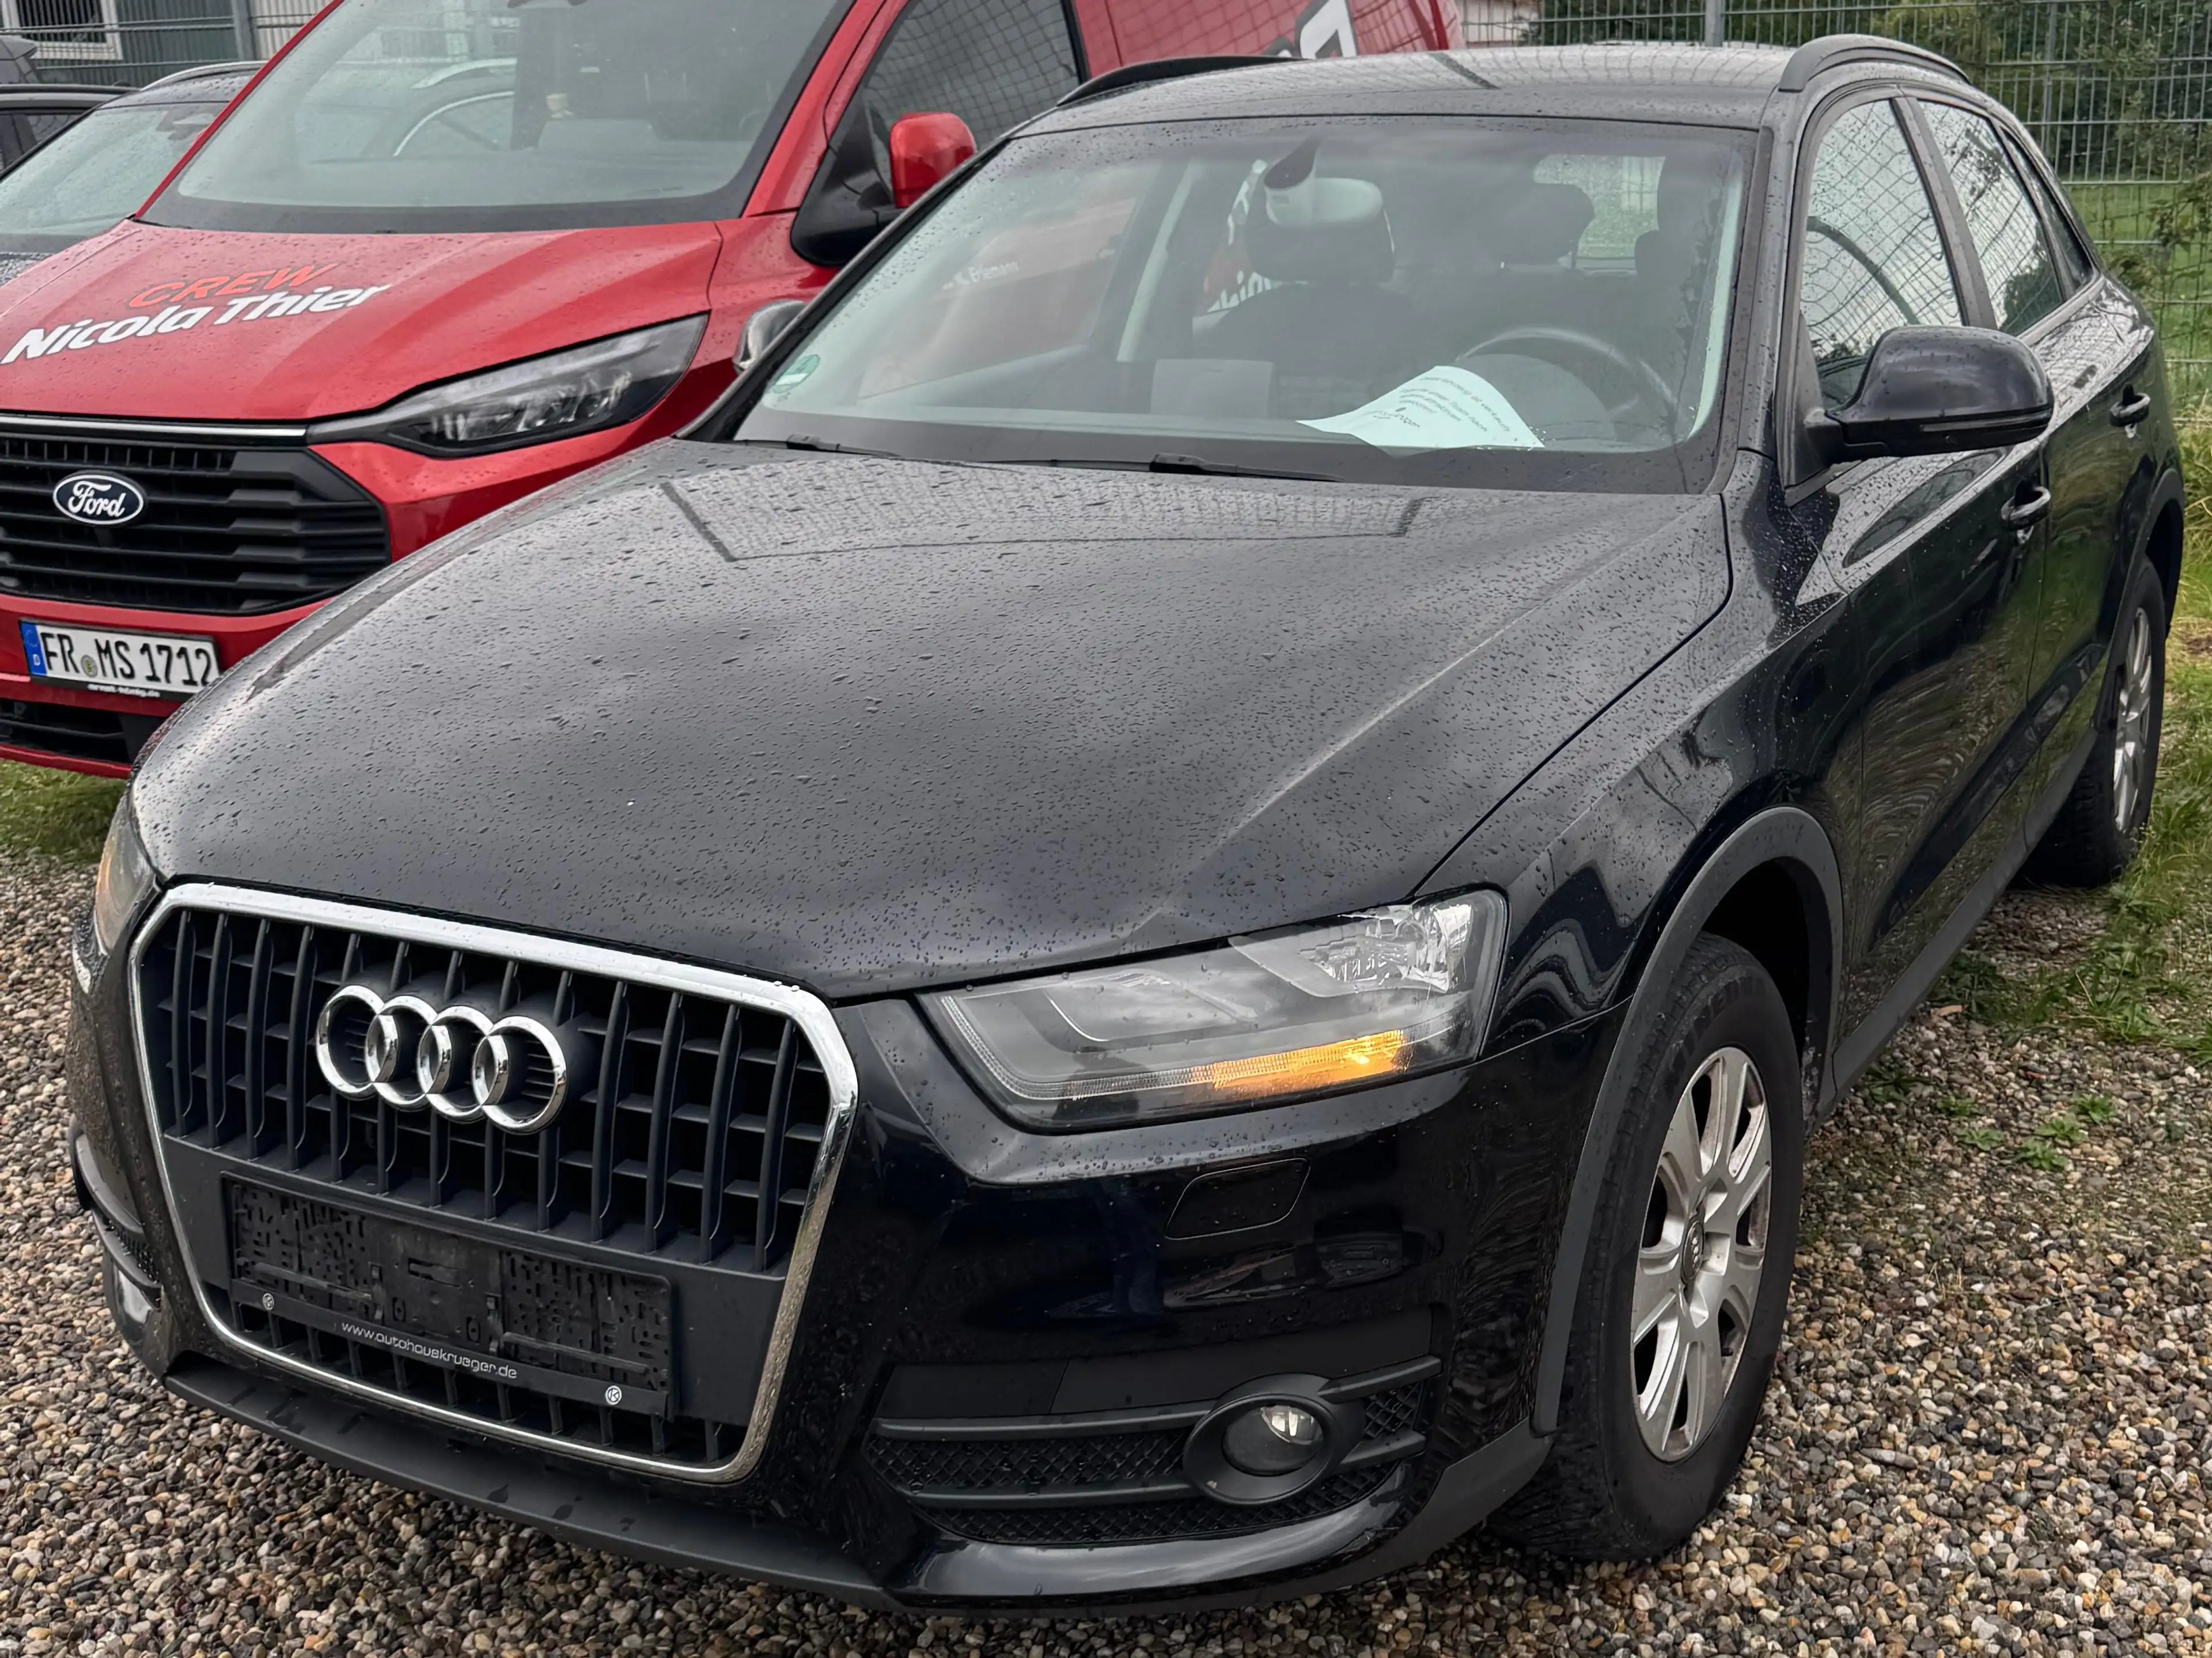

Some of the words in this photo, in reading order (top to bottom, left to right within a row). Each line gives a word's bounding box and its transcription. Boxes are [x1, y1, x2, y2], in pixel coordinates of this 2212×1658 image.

[129, 262, 340, 308] CREW
[0, 305, 214, 364] Nicola
[214, 283, 393, 324] Thier
[67, 480, 127, 518] Ford
[40, 631, 80, 674] FR
[94, 638, 135, 680] MS
[139, 642, 213, 686] 1712
[341, 1321, 518, 1380] www.autohauskrueger.de
